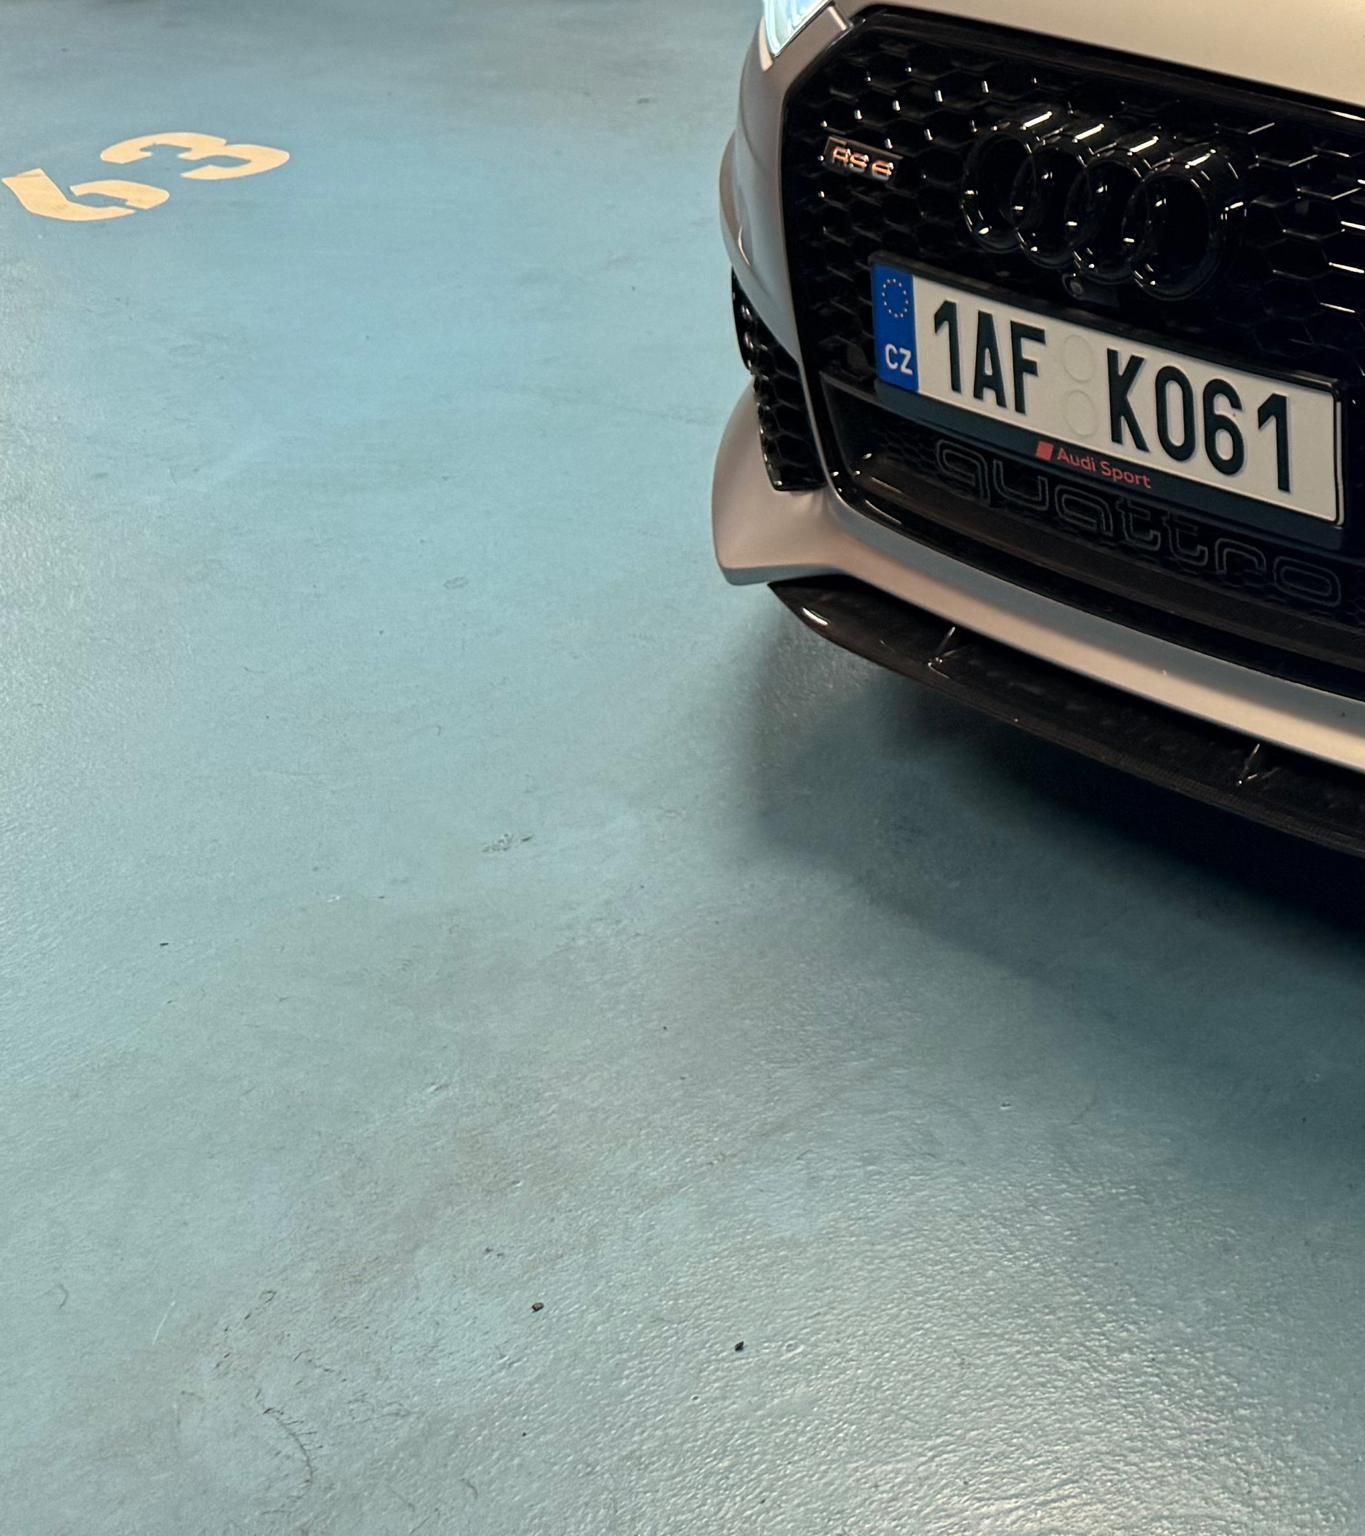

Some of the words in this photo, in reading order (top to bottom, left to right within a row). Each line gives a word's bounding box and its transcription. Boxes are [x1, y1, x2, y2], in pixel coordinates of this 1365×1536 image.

[1, 132, 291, 222] 63
[885, 344, 914, 375] CZ
[933, 300, 1047, 415] 1AF
[1106, 348, 1291, 493] K061
[1057, 448, 1097, 472] Audi
[1099, 461, 1152, 490] Sport
[938, 439, 1341, 606] quattro
